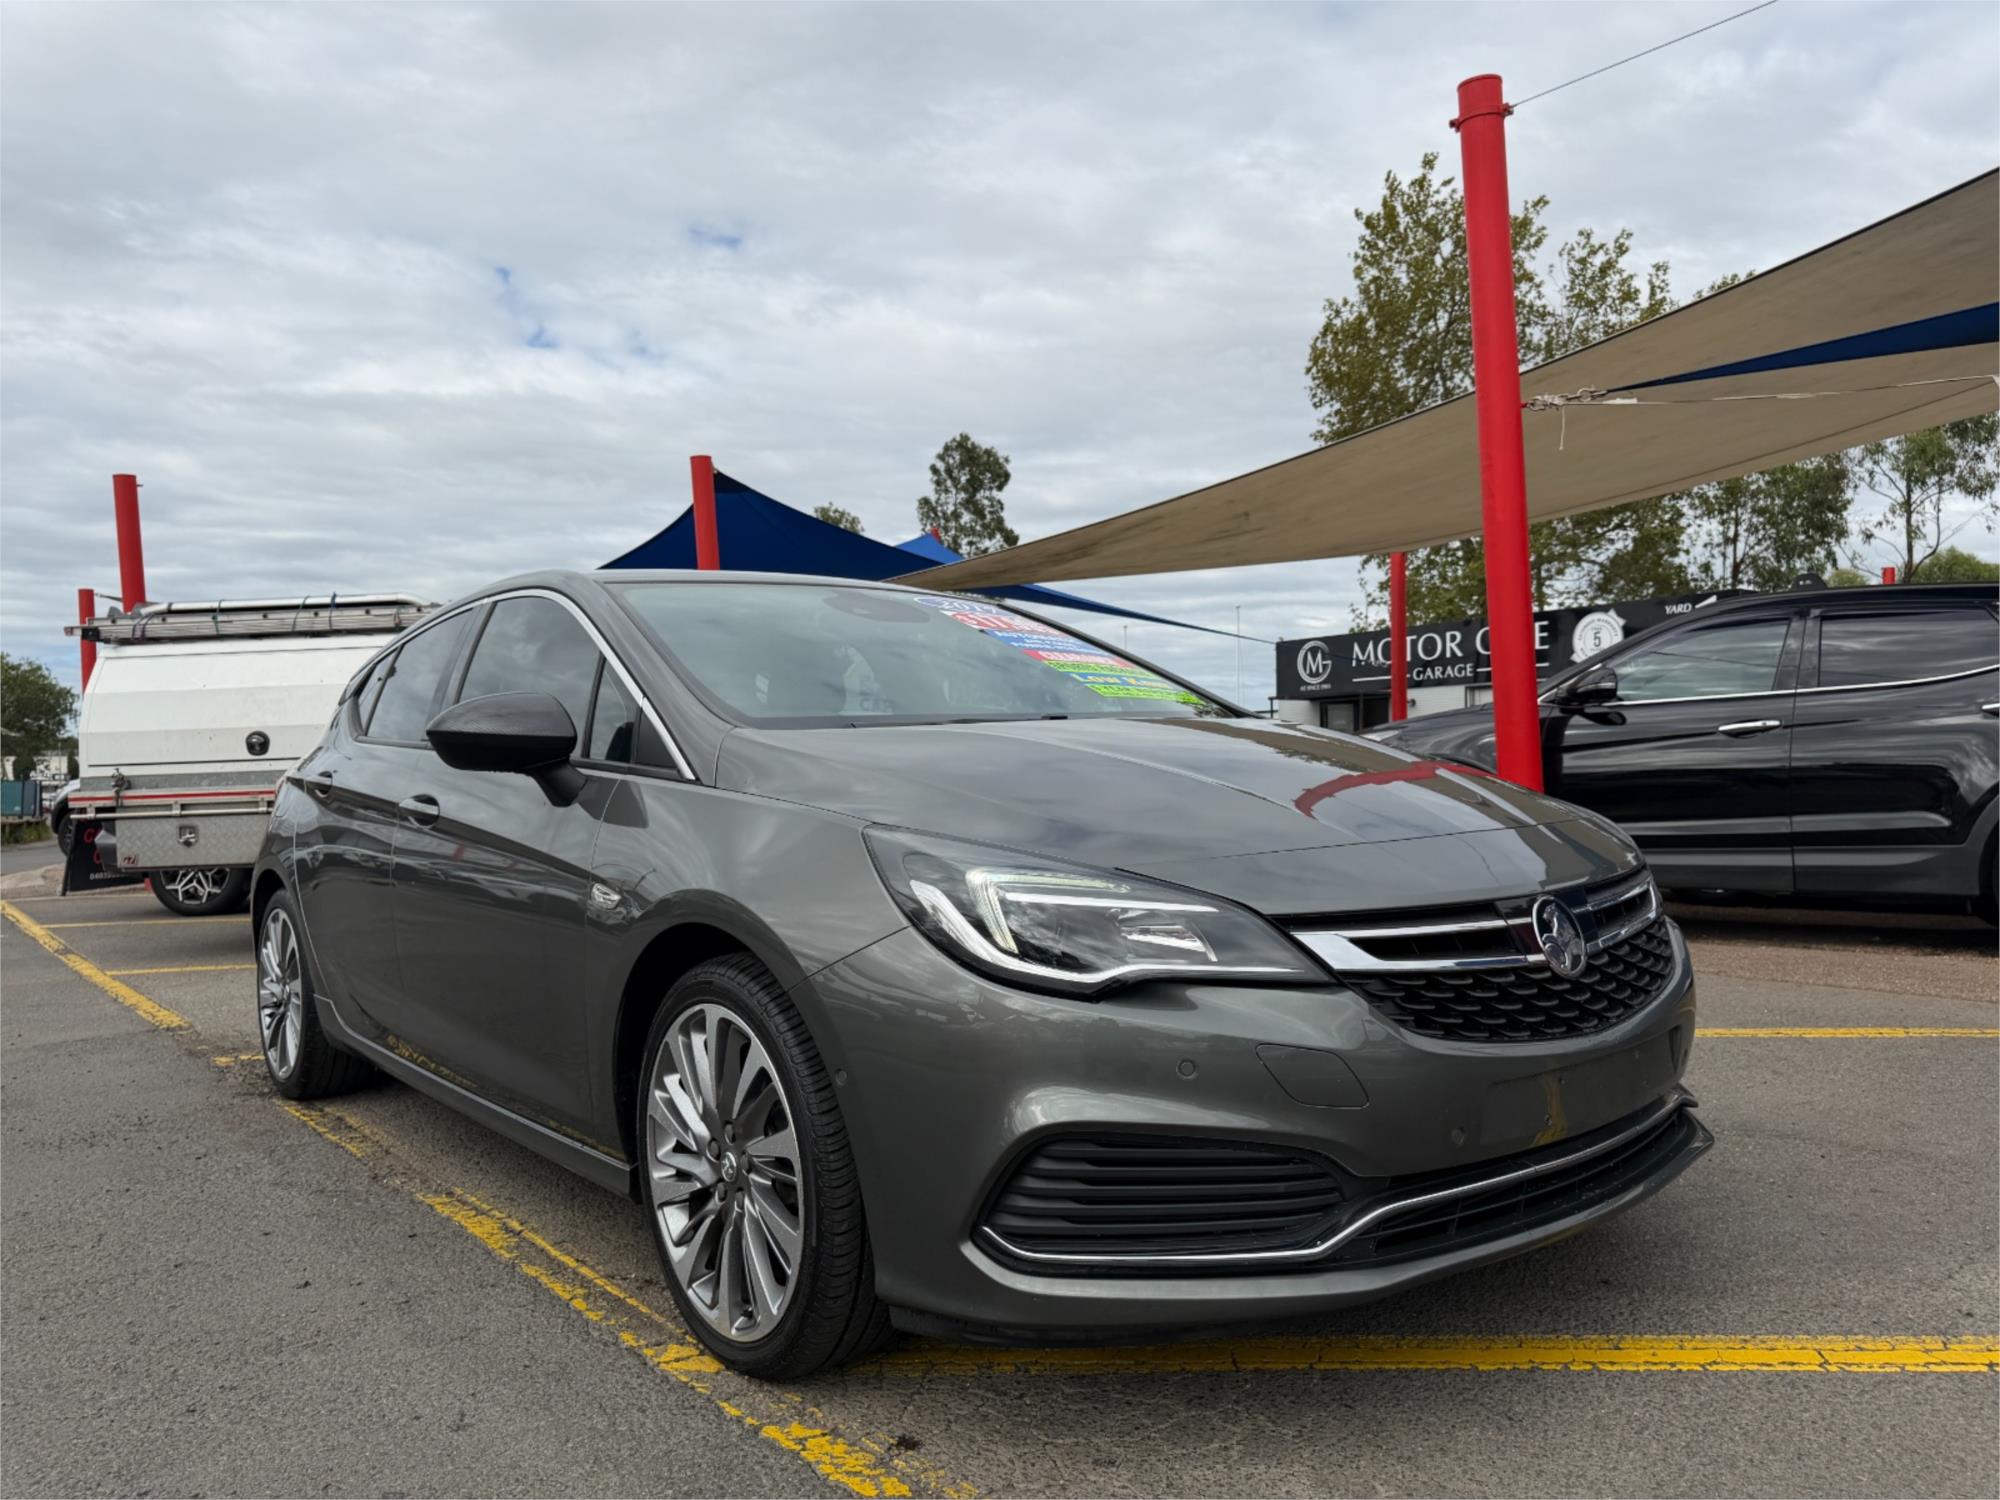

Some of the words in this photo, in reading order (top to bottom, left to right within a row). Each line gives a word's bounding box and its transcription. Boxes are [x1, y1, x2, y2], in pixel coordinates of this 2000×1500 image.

[1665, 602, 1693, 615] YARD
[1352, 630, 1464, 667] MOTOR
[1475, 620, 1550, 655] OE
[1593, 630, 1602, 648] 5
[1412, 663, 1475, 681] GARAGE
